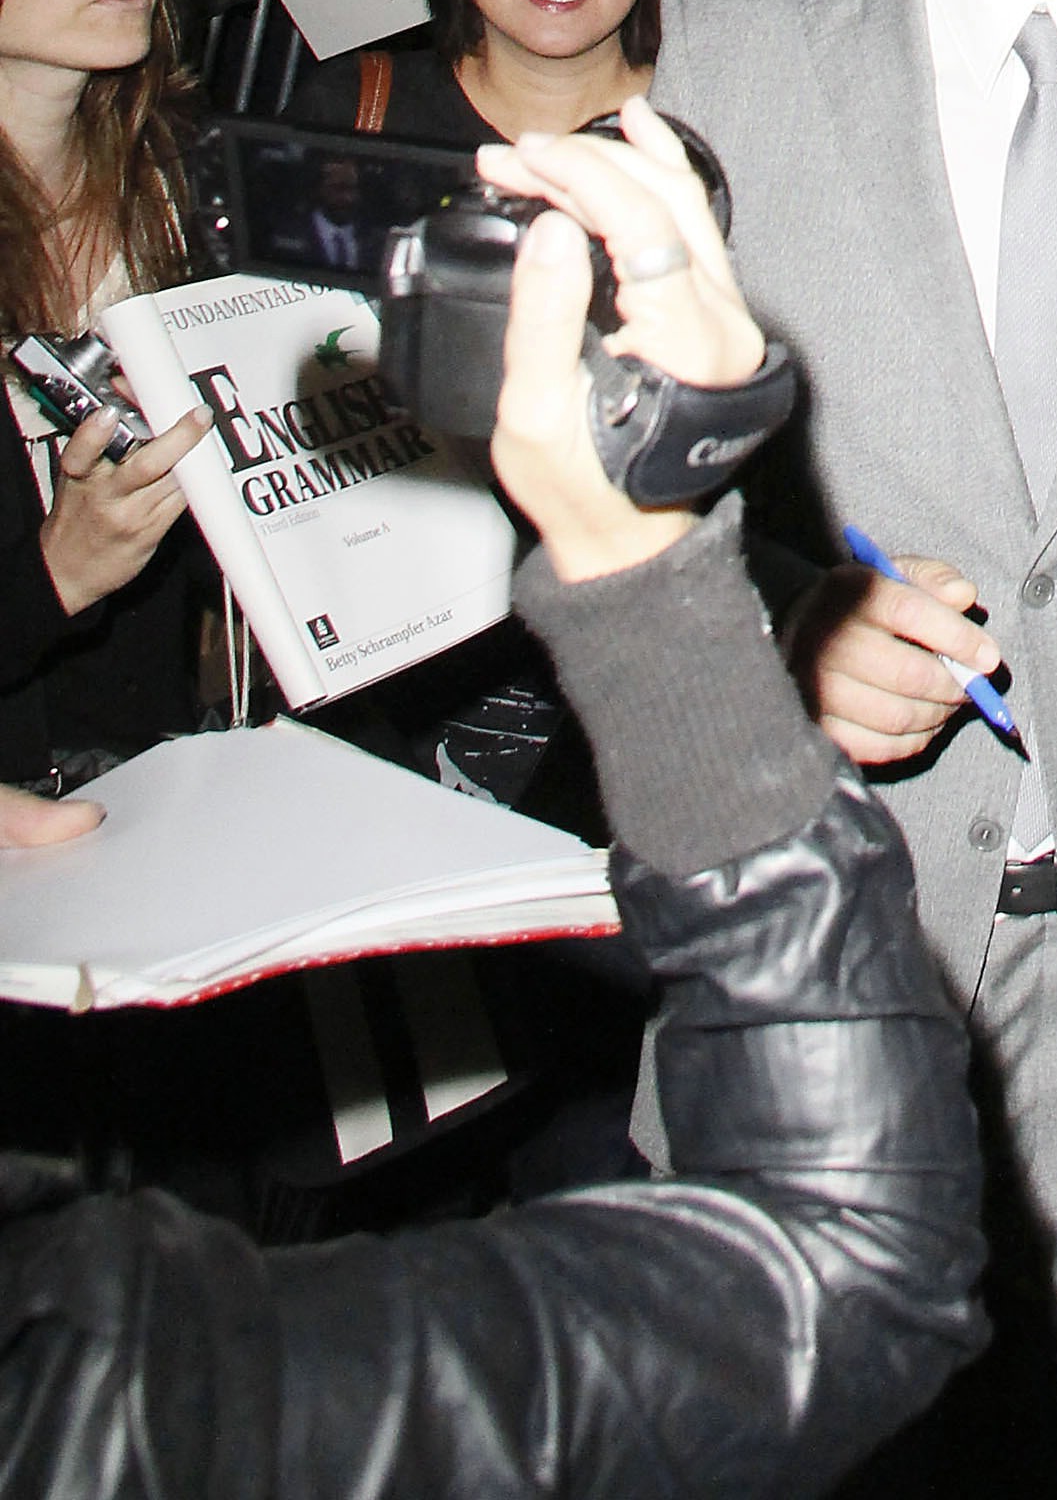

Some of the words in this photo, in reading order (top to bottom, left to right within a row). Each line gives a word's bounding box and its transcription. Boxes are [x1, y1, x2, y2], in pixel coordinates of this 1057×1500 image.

[160, 280, 306, 333] FUNDAMENTALS
[241, 423, 436, 517] GRAMMAR
[342, 526, 380, 548] Volume
[380, 520, 392, 534] A
[324, 650, 358, 673] Betty
[356, 620, 425, 660] Schrampfer
[425, 607, 454, 630] Azar
